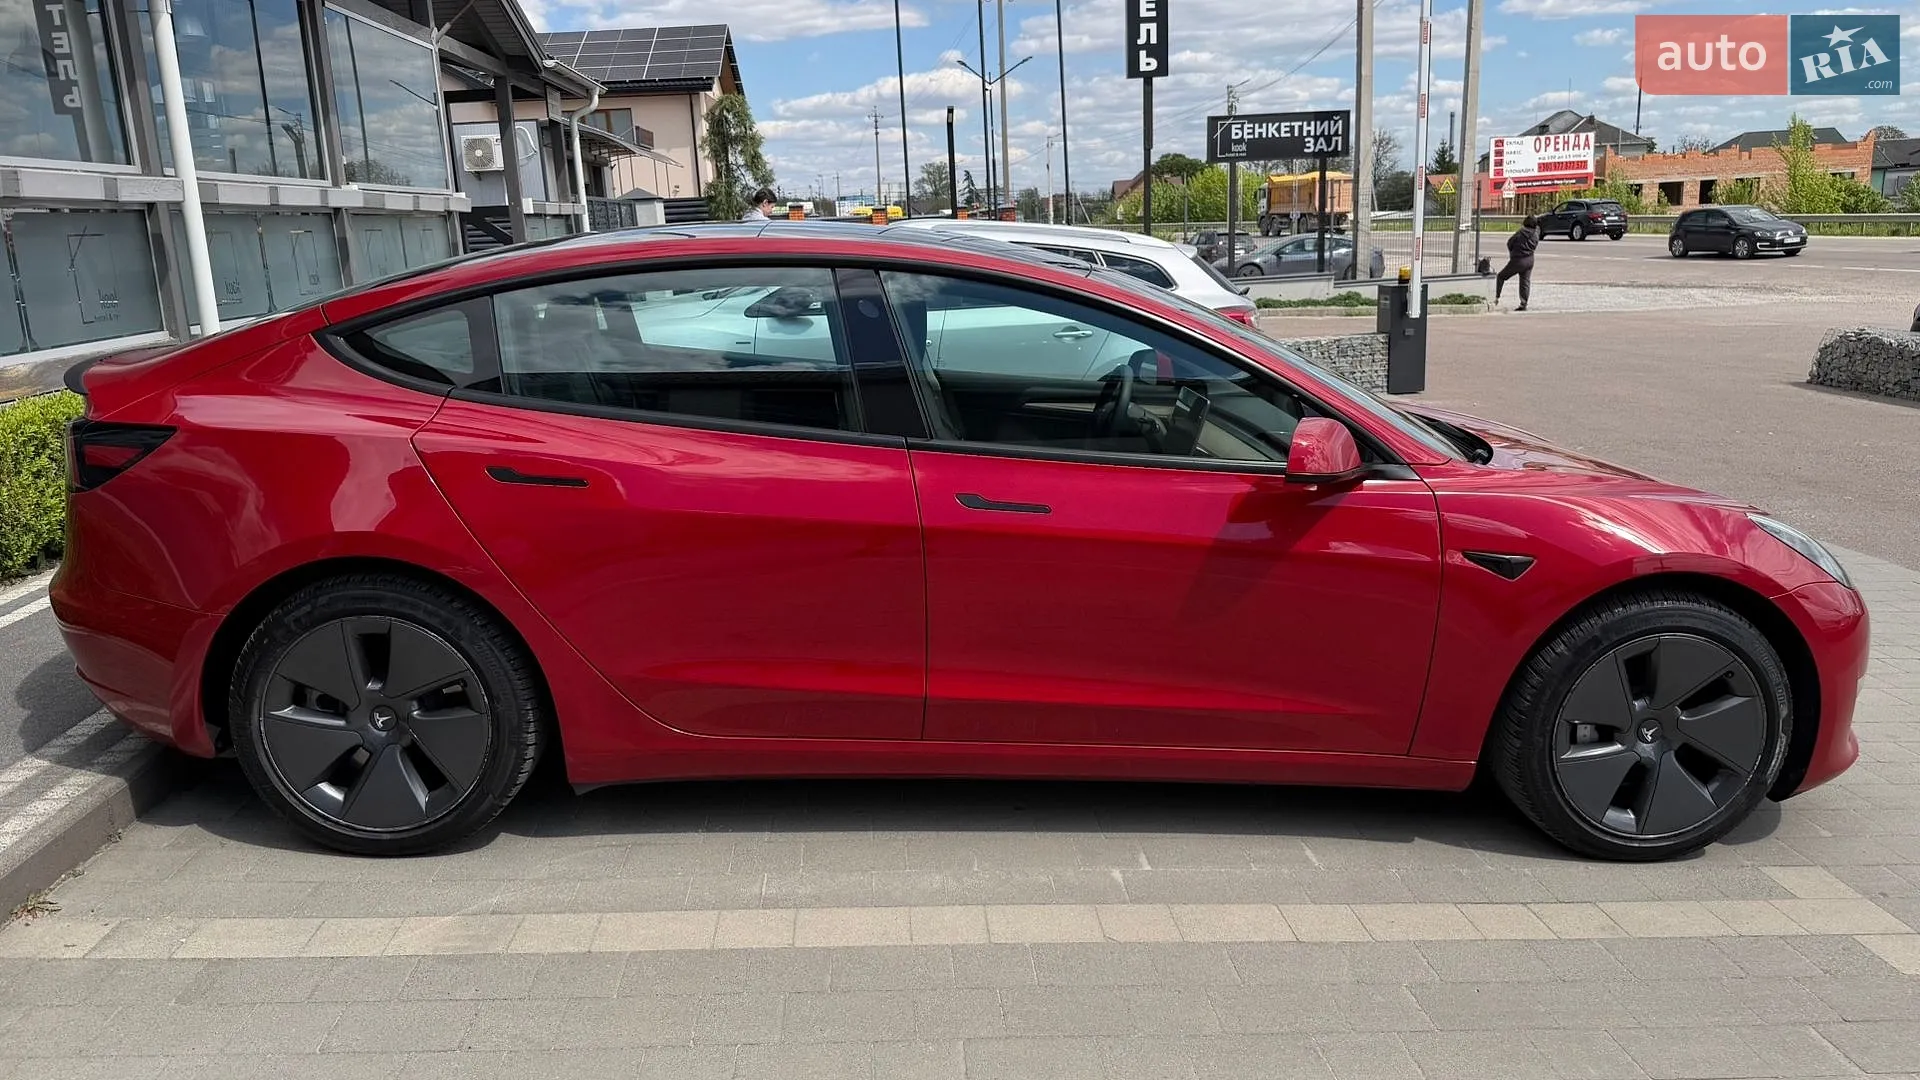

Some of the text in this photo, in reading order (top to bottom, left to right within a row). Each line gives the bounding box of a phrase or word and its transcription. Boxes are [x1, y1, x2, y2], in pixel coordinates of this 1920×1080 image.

[1137, 0, 1158, 72] ЕЛЬ
[1231, 116, 1342, 139] БЕНКЕТНИЙ
[1304, 137, 1342, 153] ЗАЛ
[1533, 134, 1591, 154] ОРЕНДА
